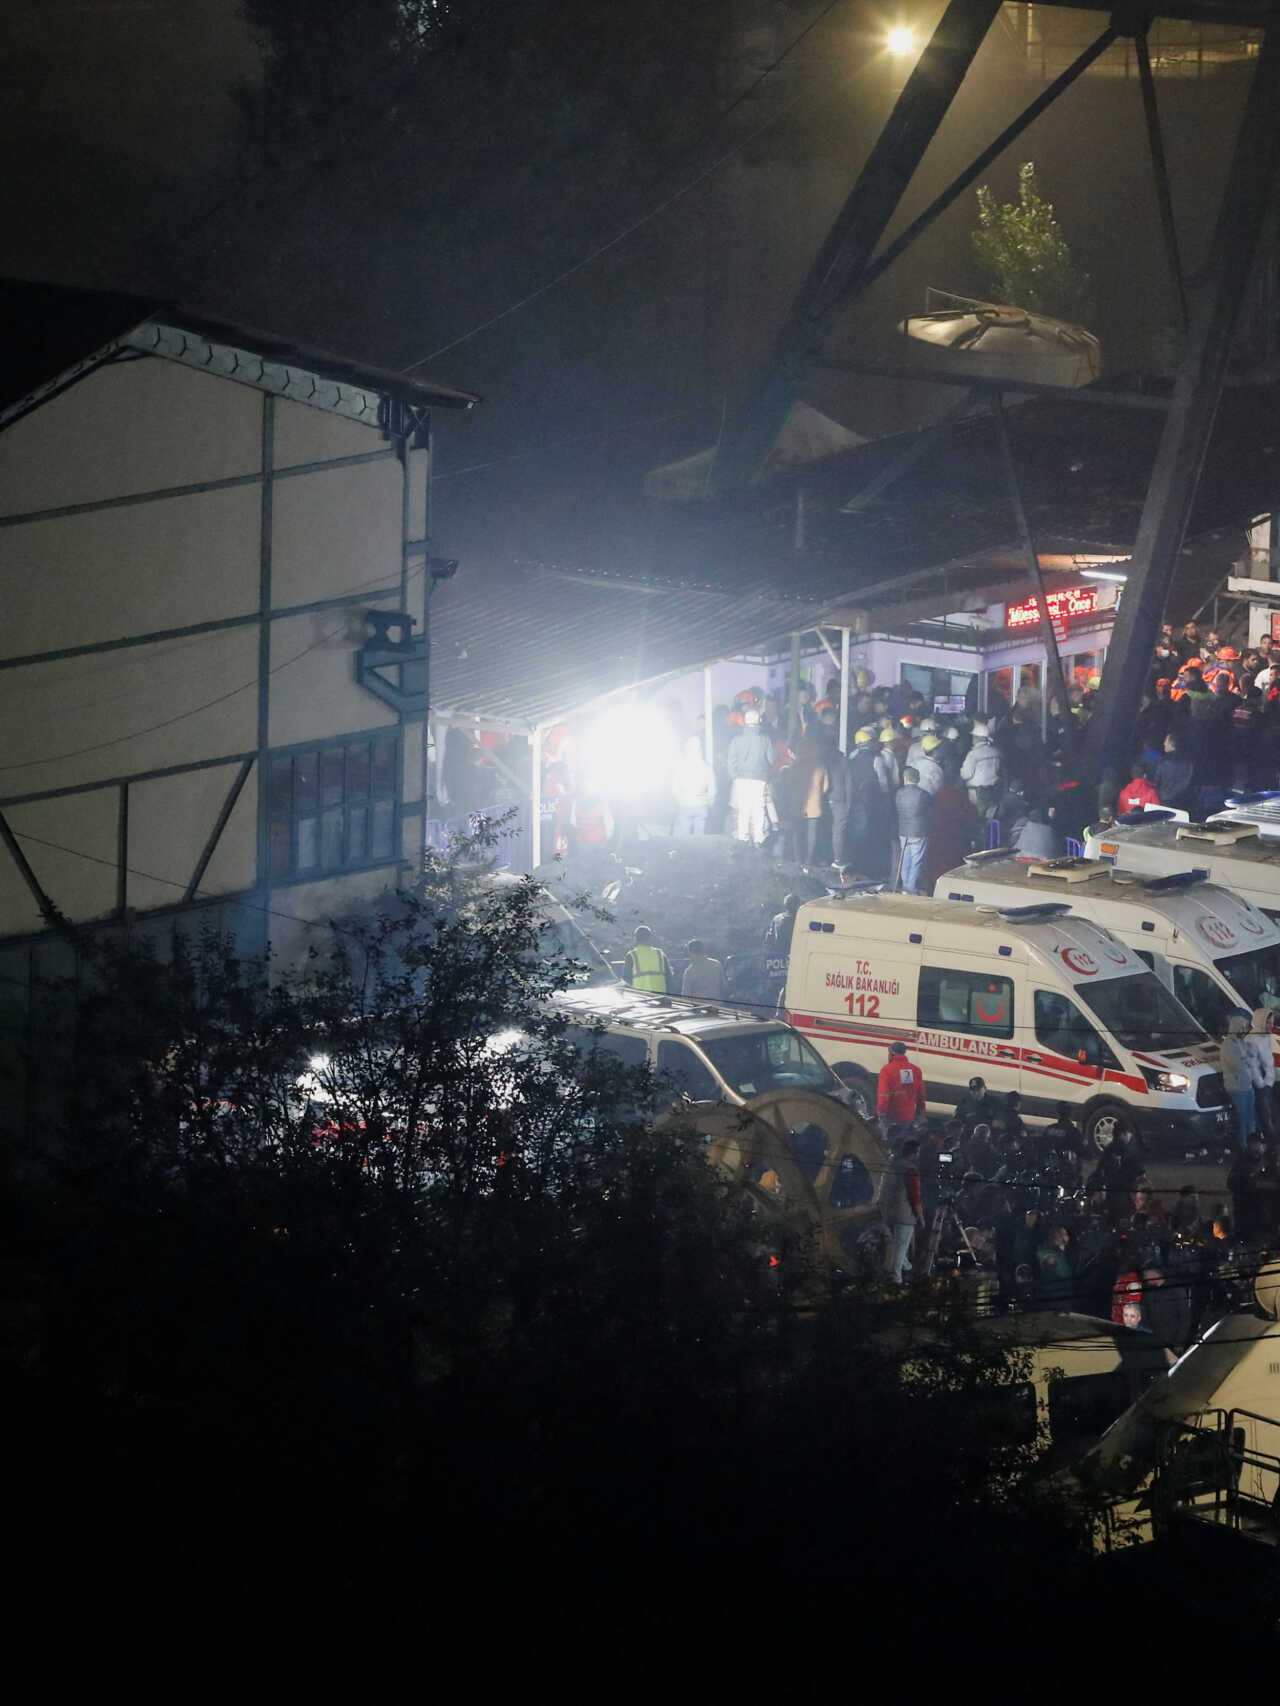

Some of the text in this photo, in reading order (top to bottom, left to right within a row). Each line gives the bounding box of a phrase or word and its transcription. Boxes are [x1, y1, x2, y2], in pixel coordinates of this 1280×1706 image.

[856, 960, 872, 976] T.C.
[825, 971, 900, 996] SAĞLIK BAKANLIĞI
[844, 993, 880, 1018] 112
[919, 1032, 999, 1056] AMBULANS
